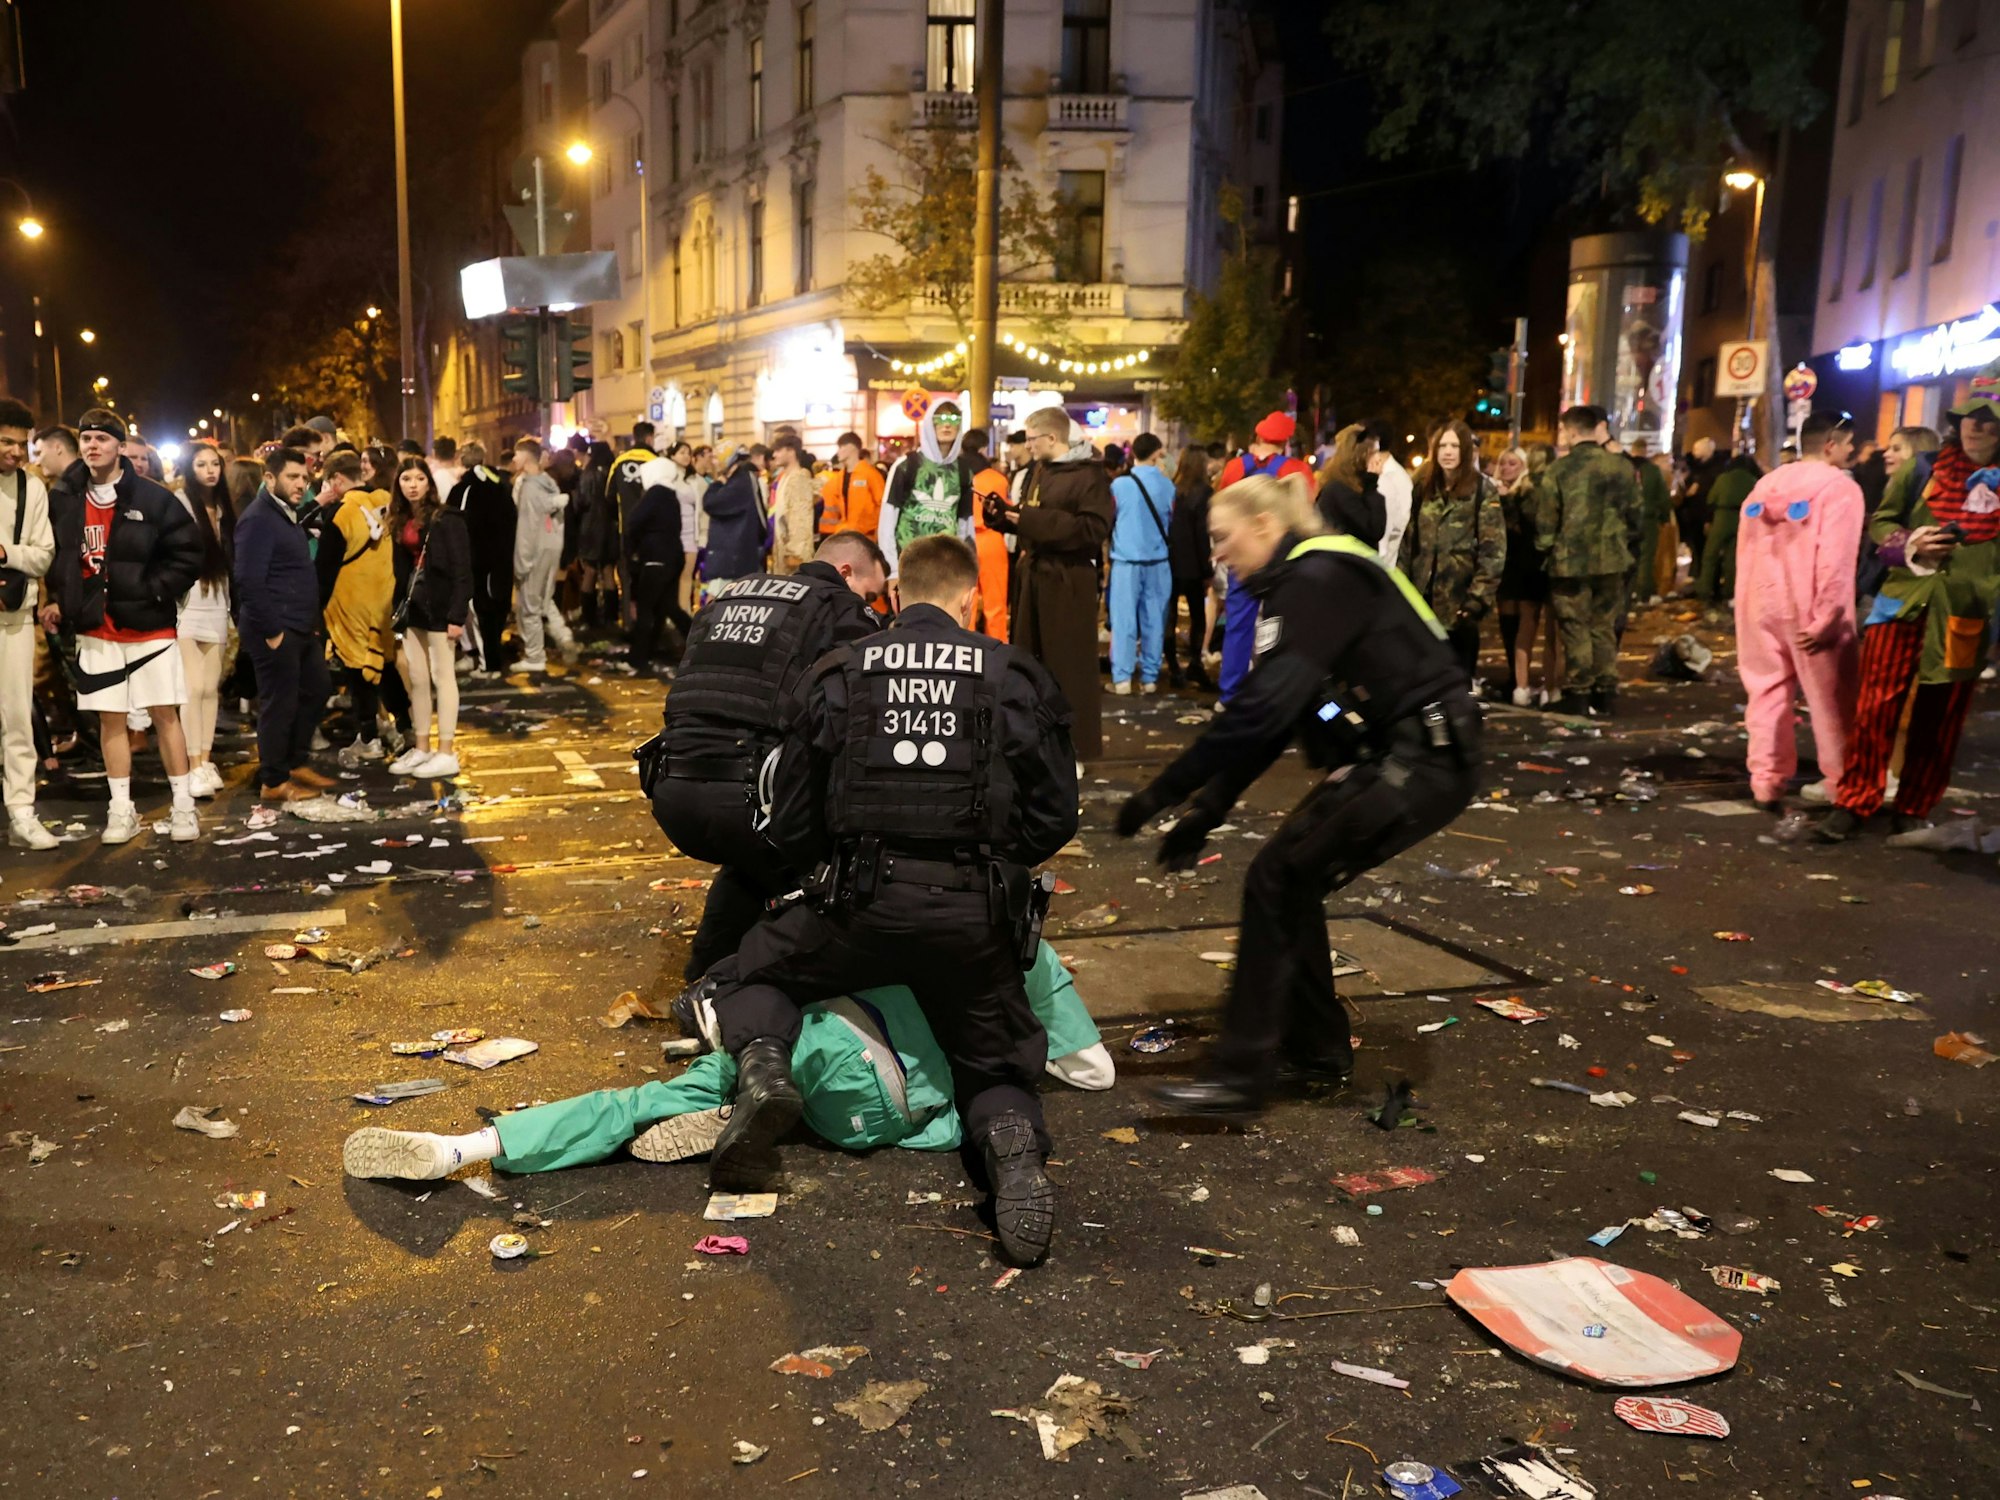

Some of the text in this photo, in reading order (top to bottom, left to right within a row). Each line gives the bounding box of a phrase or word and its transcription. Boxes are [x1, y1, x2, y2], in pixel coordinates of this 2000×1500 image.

[717, 579, 810, 601] POLIZEI
[720, 605, 774, 624] NRW
[711, 623, 765, 644] 31413
[863, 643, 983, 673] POLIZEI
[888, 678, 957, 705] NRW
[883, 709, 957, 737] 31413
